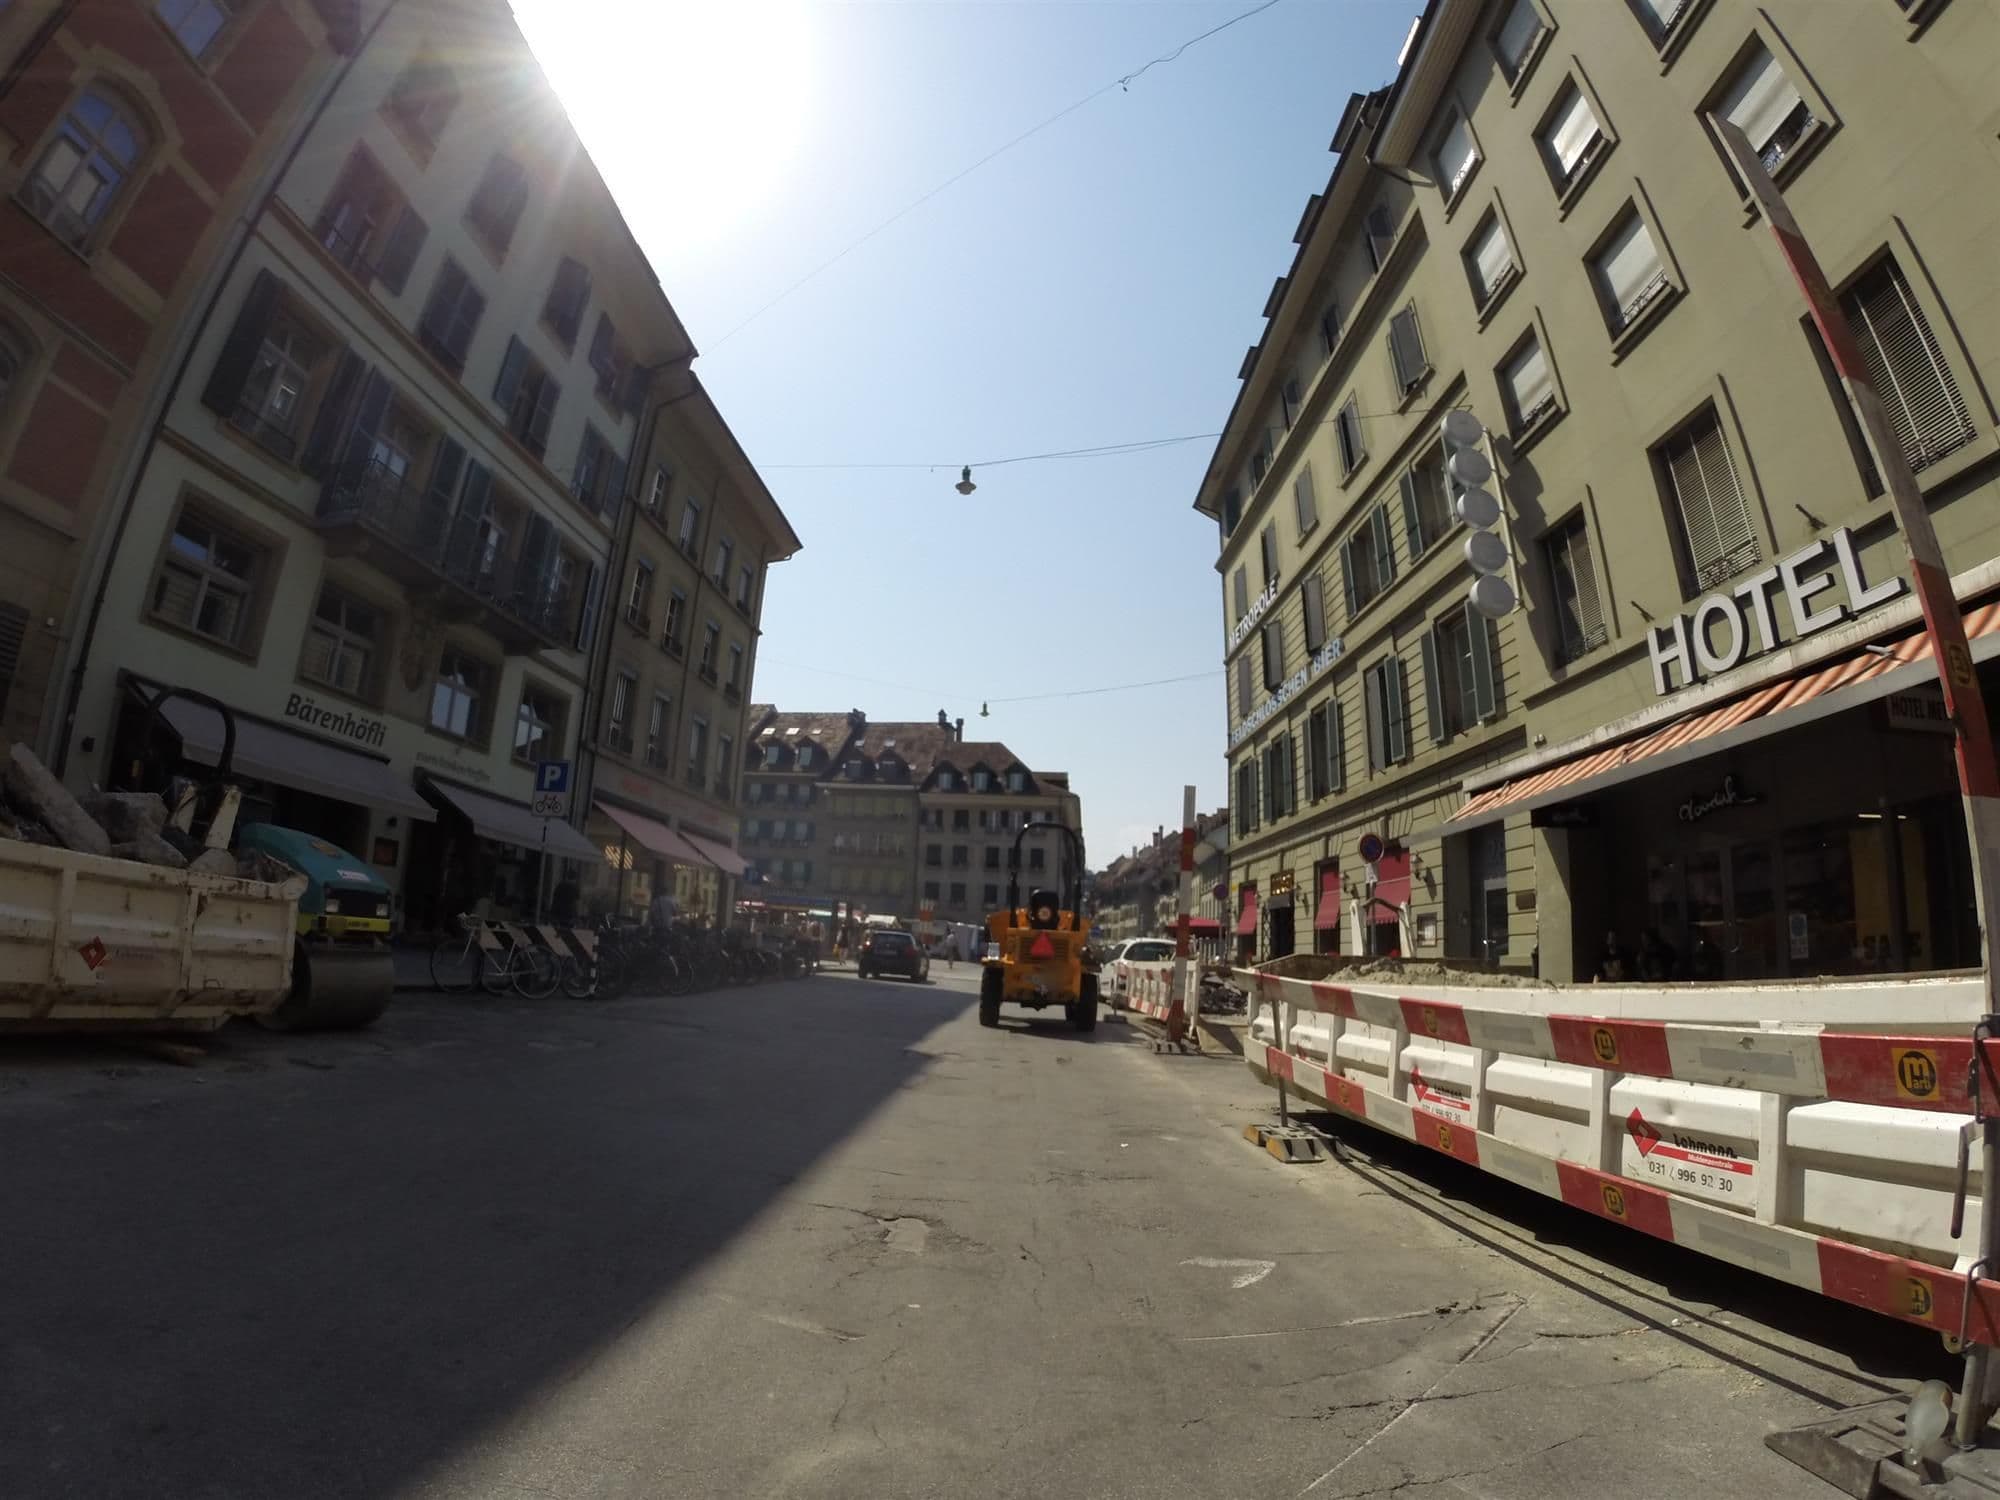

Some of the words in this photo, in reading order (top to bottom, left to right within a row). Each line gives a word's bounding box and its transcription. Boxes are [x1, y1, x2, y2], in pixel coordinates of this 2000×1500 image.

[1229, 579, 1277, 652] METROPOLE
[1646, 526, 1905, 696] HOTEL
[1313, 638, 1341, 673] BIER
[284, 693, 388, 748] Bärenhöfli
[1891, 694, 1925, 719] HOTEL
[543, 765, 562, 789] P
[1648, 1161, 1667, 1176] 031
[1677, 1168, 1696, 1183] 996
[1701, 1174, 1714, 1188] 92
[1718, 1177, 1733, 1192] 30
